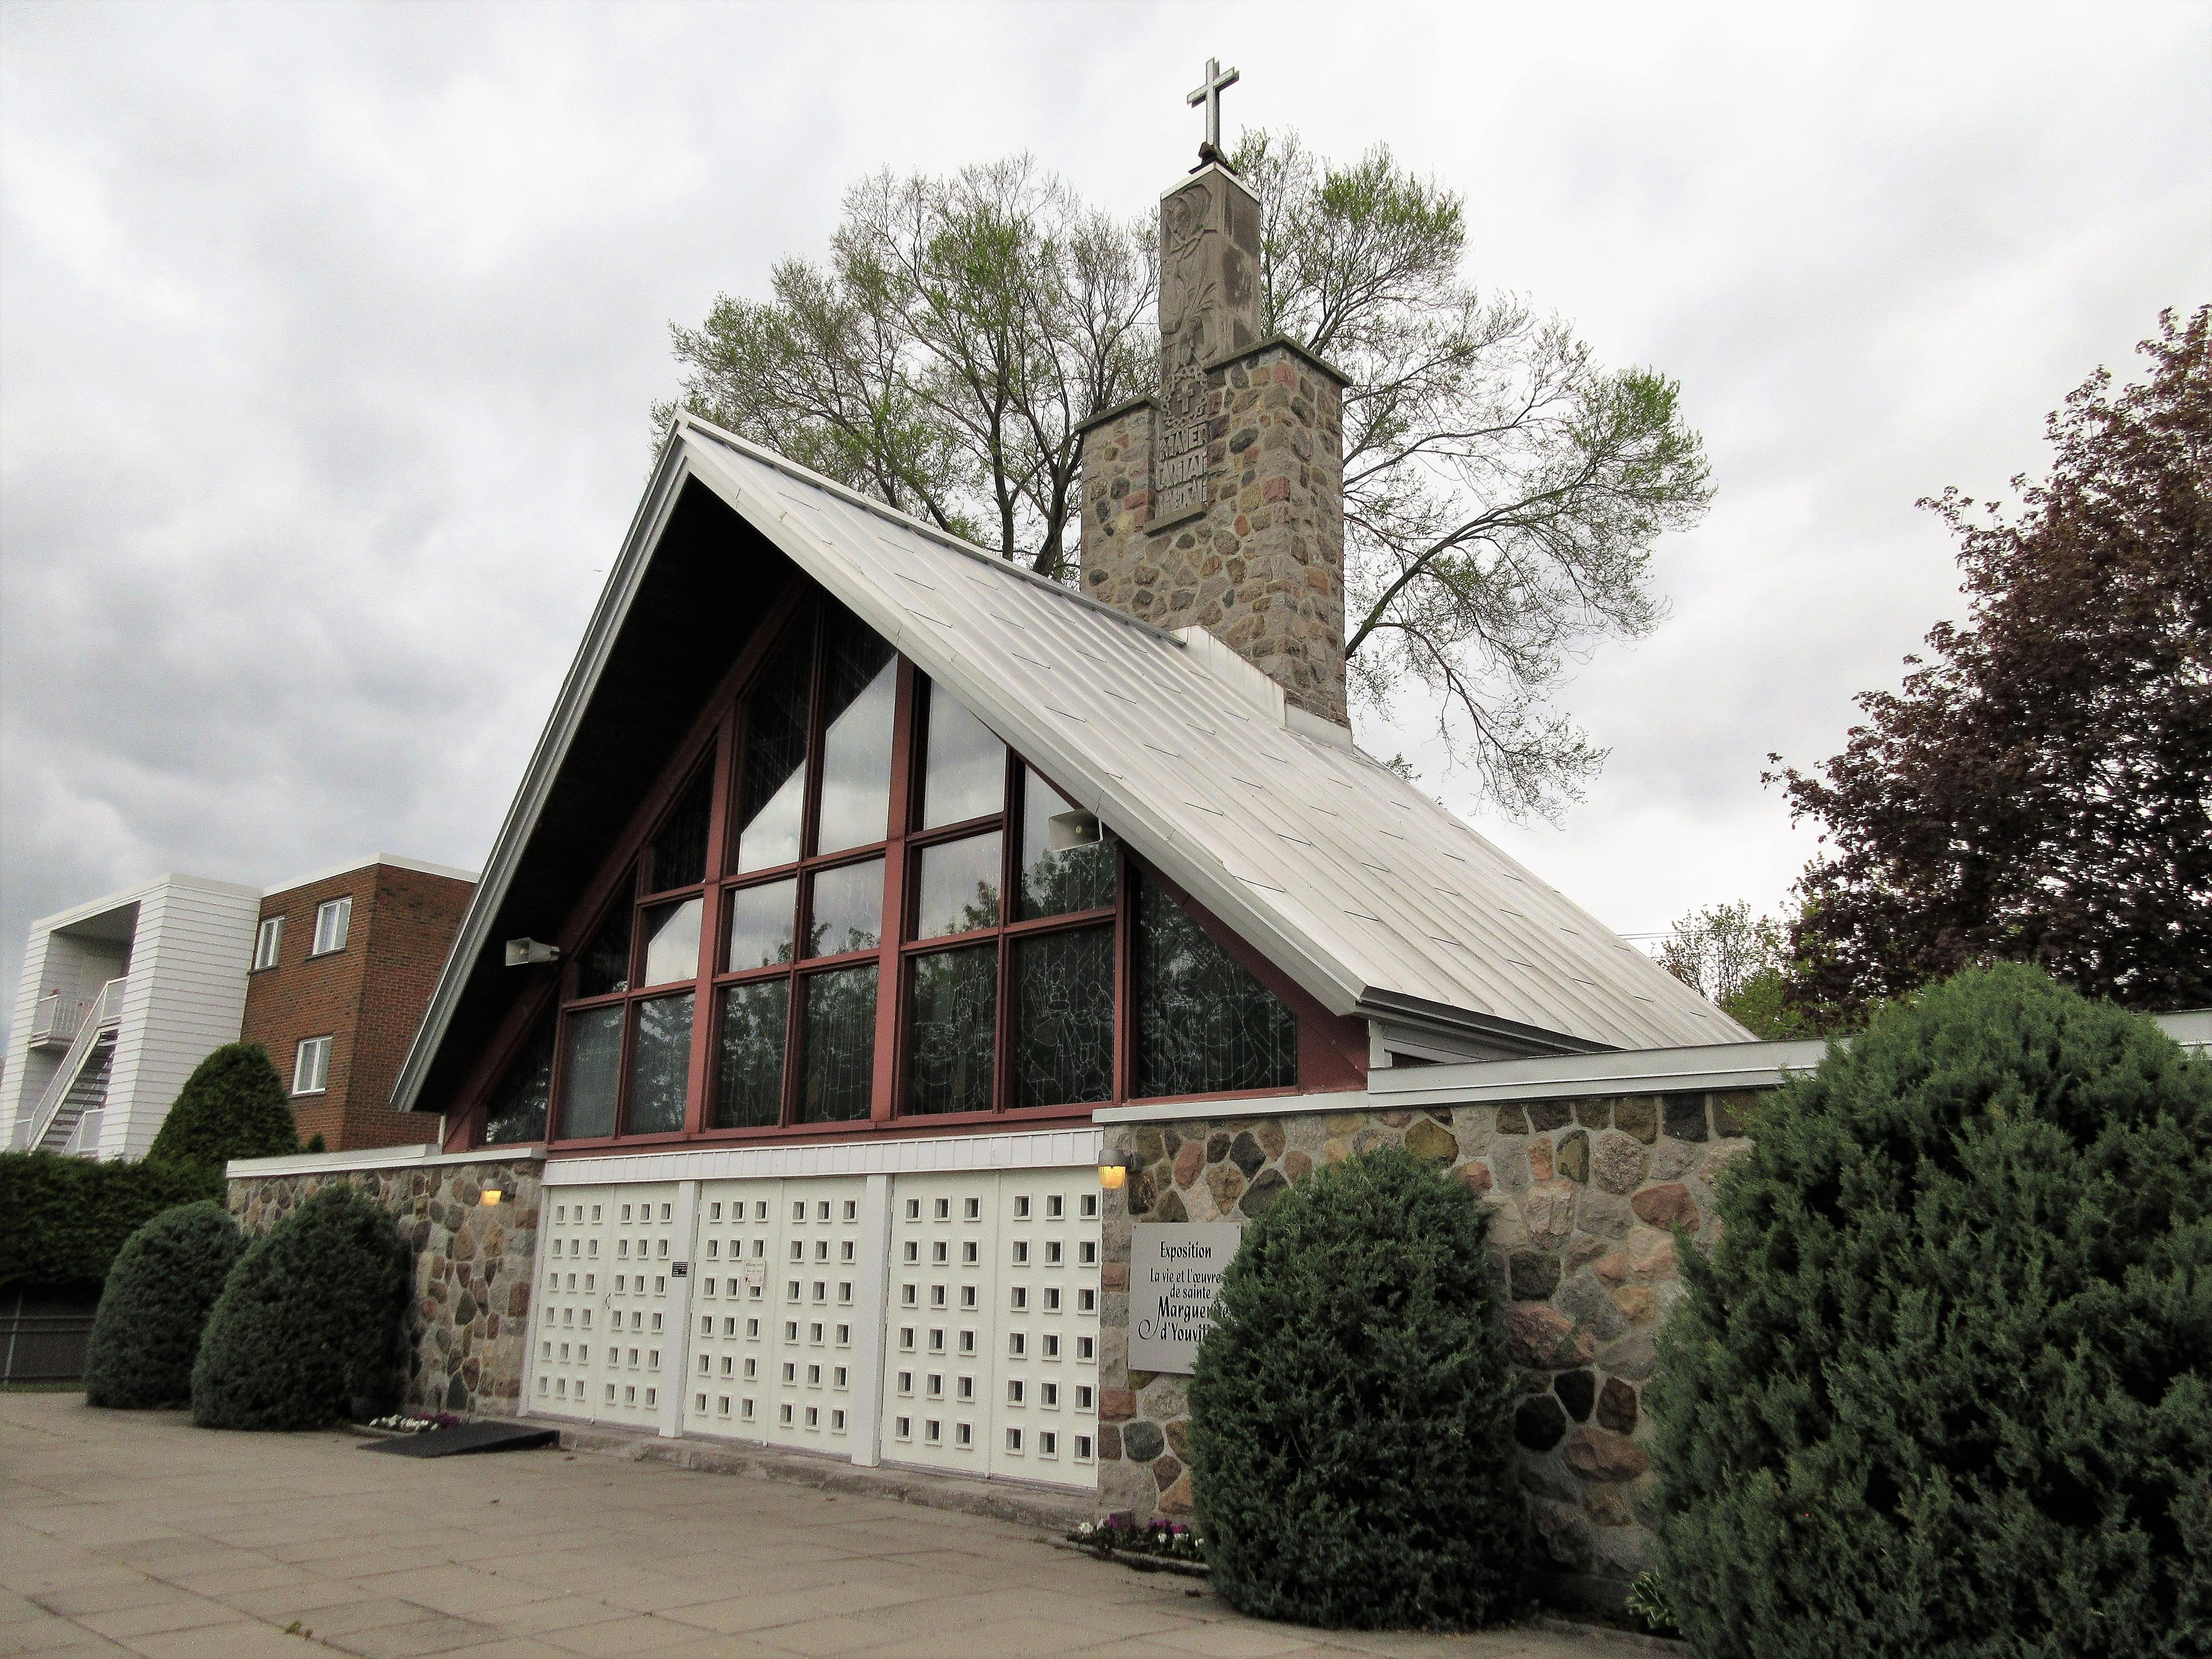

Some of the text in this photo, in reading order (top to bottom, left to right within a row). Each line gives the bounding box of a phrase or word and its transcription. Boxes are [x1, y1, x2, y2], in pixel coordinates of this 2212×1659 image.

[1160, 1241, 1211, 1262] Exposition
[1150, 1268, 1160, 1282] La
[1162, 1268, 1174, 1282] vie
[1176, 1270, 1184, 1282] et
[1170, 1283, 1211, 1298] de sainte
[1160, 1322, 1212, 1342] d'Youvil
